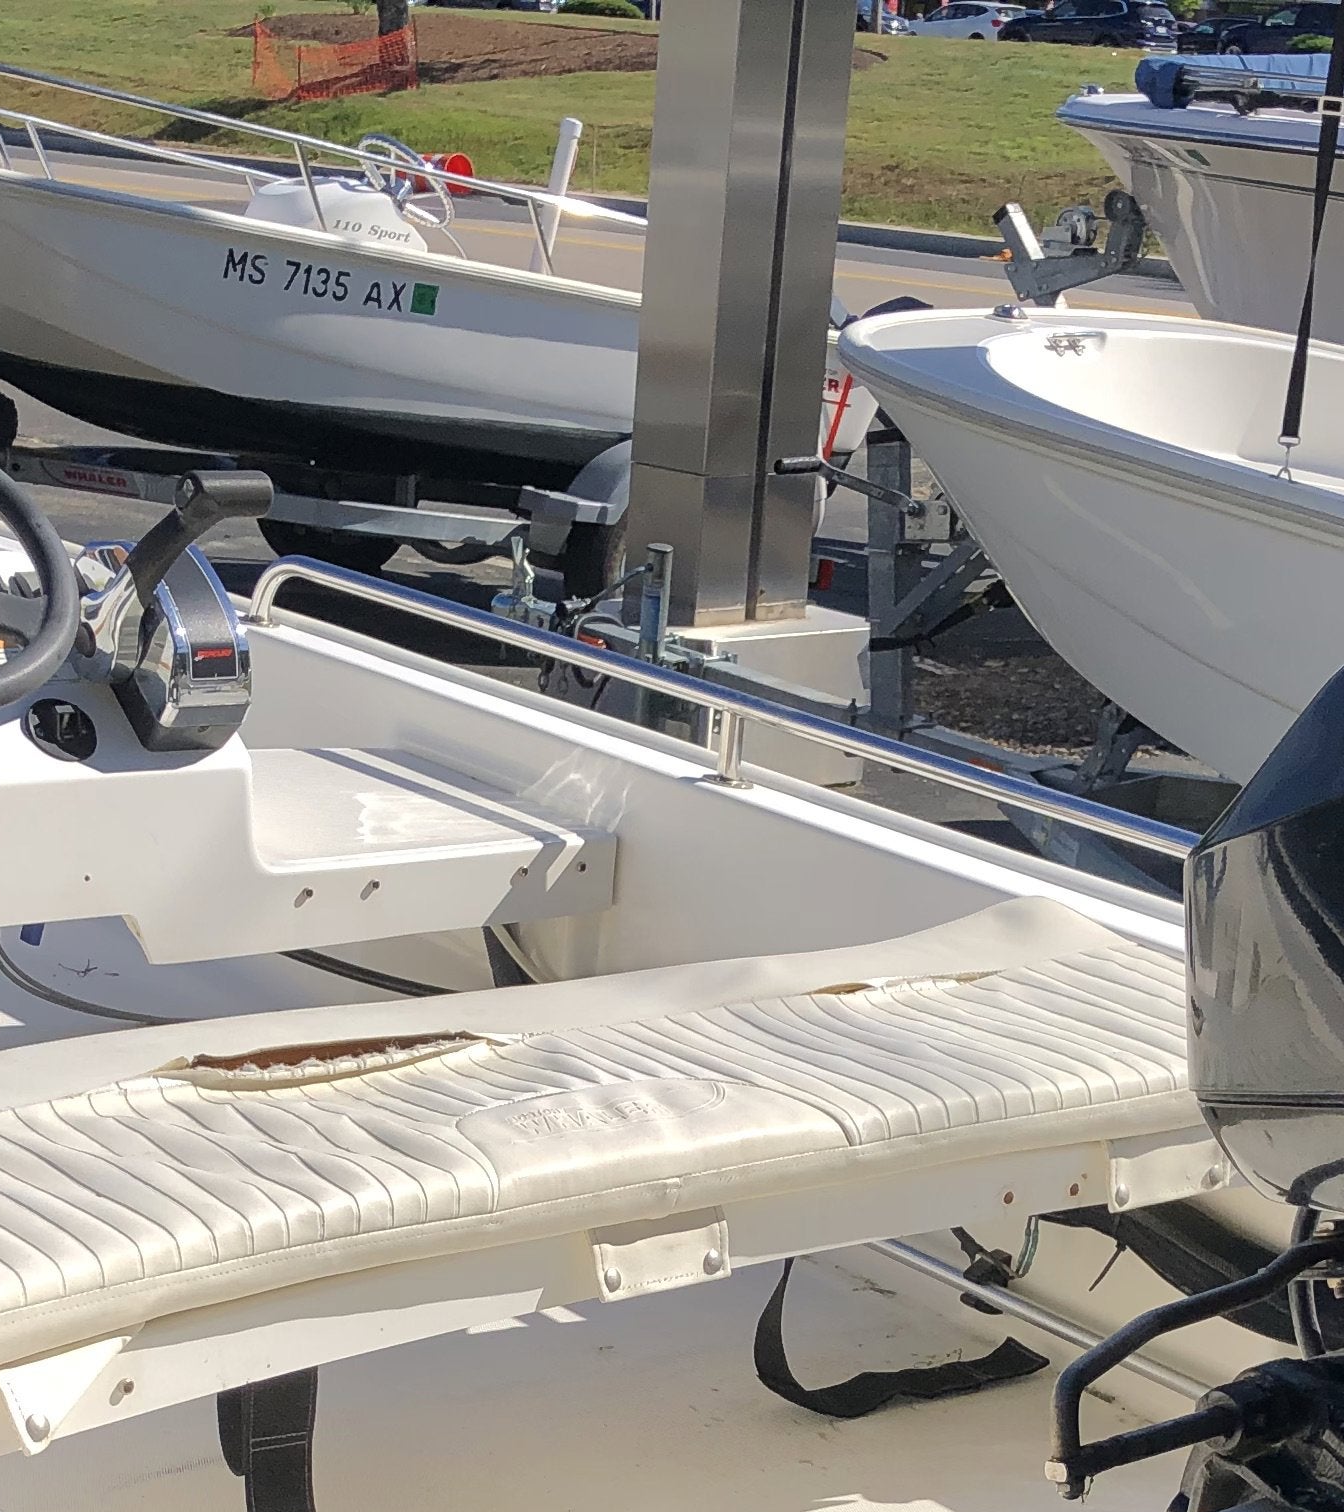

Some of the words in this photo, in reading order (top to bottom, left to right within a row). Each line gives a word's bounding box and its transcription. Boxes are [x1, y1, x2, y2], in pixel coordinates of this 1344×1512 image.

[333, 219, 362, 233] 110
[368, 225, 411, 243] Sport
[223, 247, 269, 285] MS
[283, 260, 351, 302] 7135
[362, 281, 406, 313] AX
[63, 469, 127, 487] WHALER
